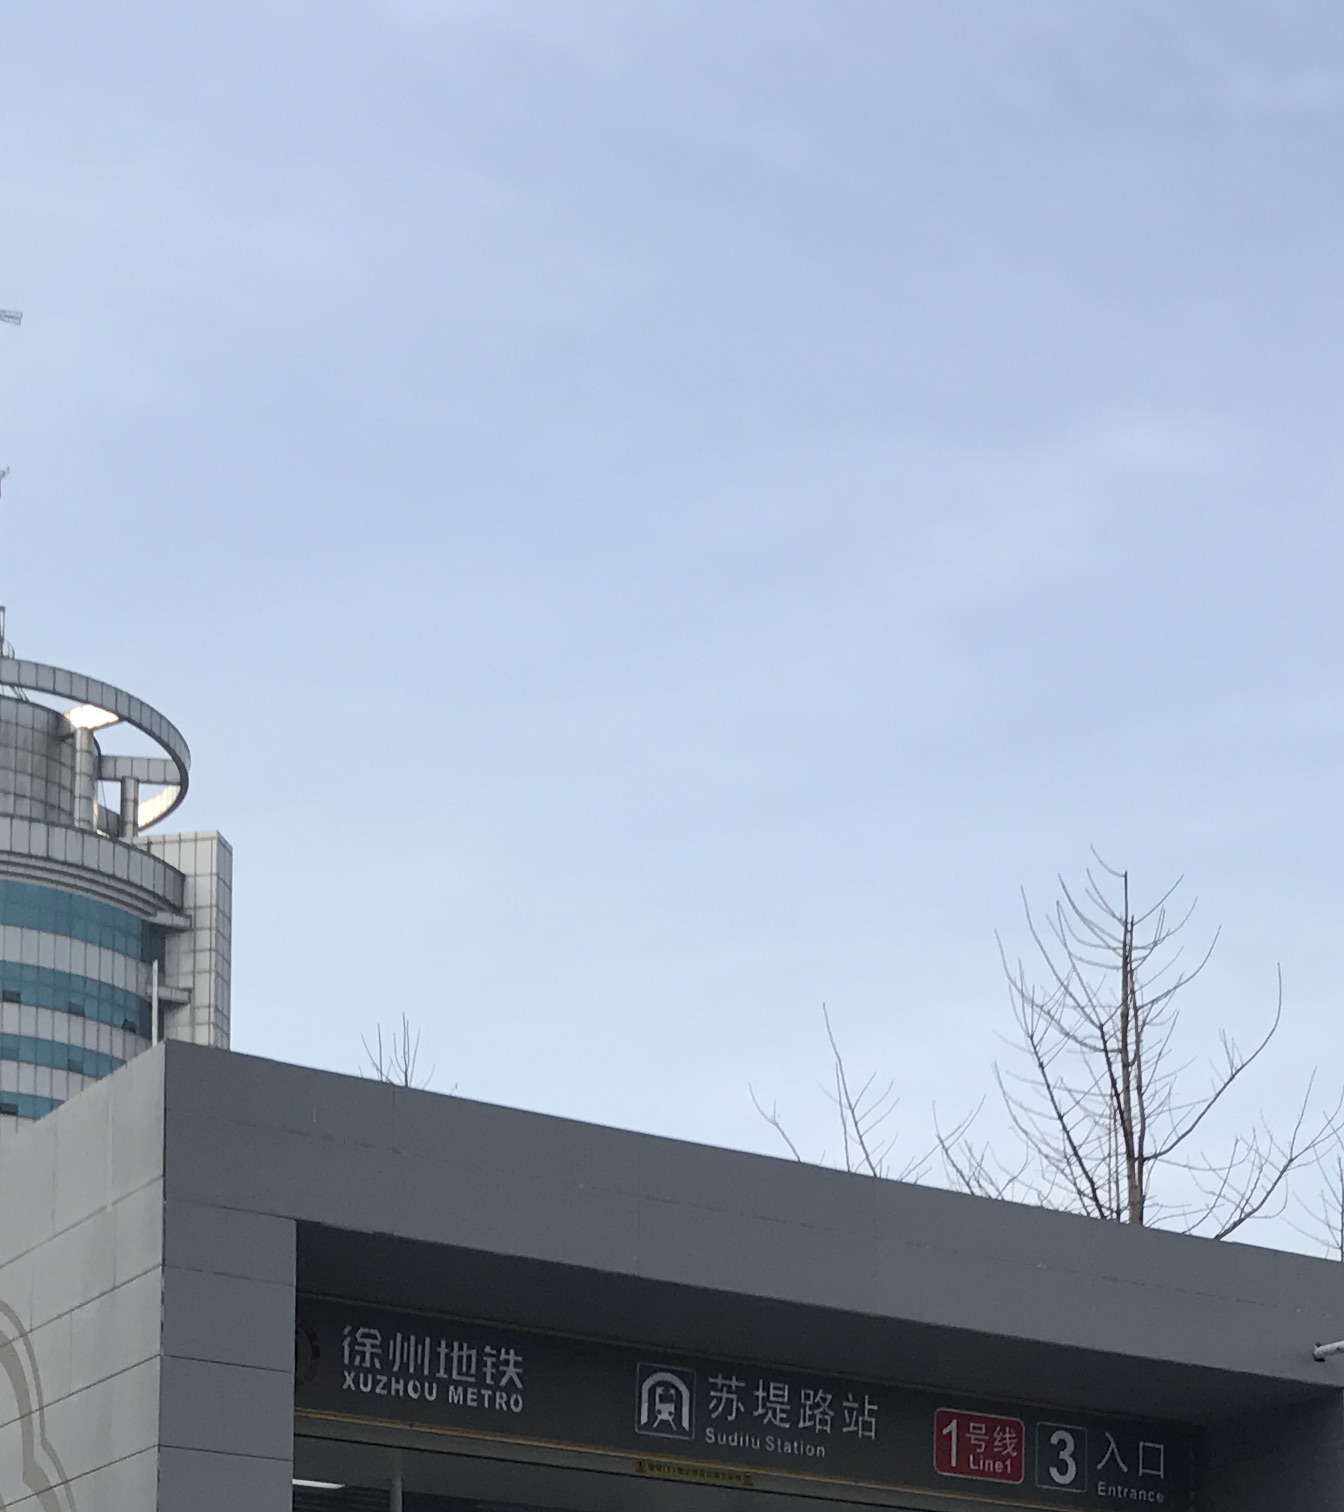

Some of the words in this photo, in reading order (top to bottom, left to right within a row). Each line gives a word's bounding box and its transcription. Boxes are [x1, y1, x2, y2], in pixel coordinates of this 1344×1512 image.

[342, 1324, 524, 1390] 徐州地铁
[342, 1369, 438, 1401] XUZHOU
[448, 1385, 524, 1413] METRO
[708, 1374, 879, 1440] 苏堤路站
[705, 1427, 761, 1450] Sudilu
[765, 1435, 826, 1459] Station
[942, 1418, 1018, 1468] 1号线
[969, 1453, 1013, 1474] Line1
[1049, 1430, 1077, 1485] 3
[1096, 1431, 1165, 1480] 入口
[1097, 1481, 1165, 1503] Entrance
